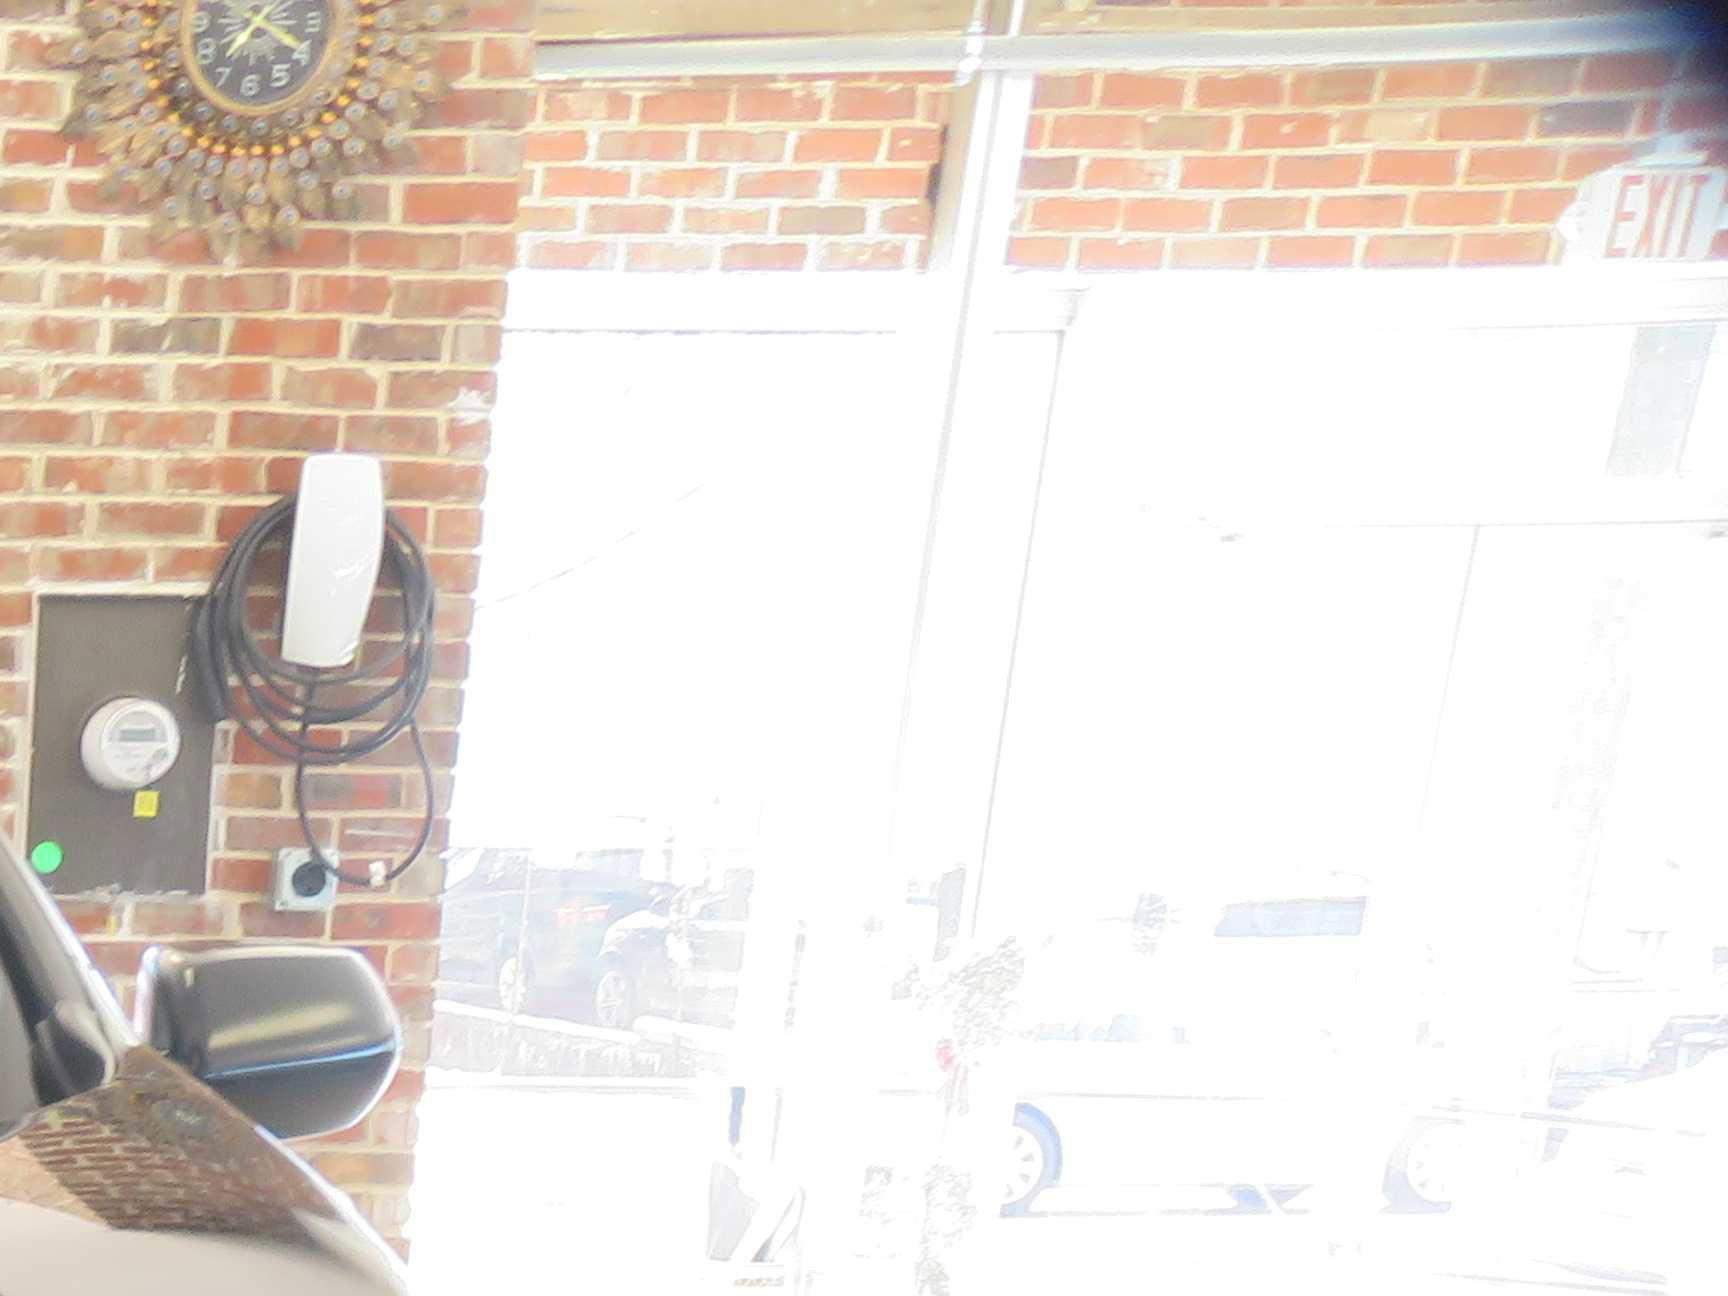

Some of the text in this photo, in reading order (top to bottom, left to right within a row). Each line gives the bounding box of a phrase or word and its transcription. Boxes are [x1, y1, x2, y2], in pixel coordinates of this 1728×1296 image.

[197, 38, 217, 65] 8
[292, 39, 313, 66] 4
[215, 66, 233, 89] 7
[240, 73, 261, 97] 6
[270, 63, 292, 88] 5
[1603, 175, 1711, 258] EXIT
